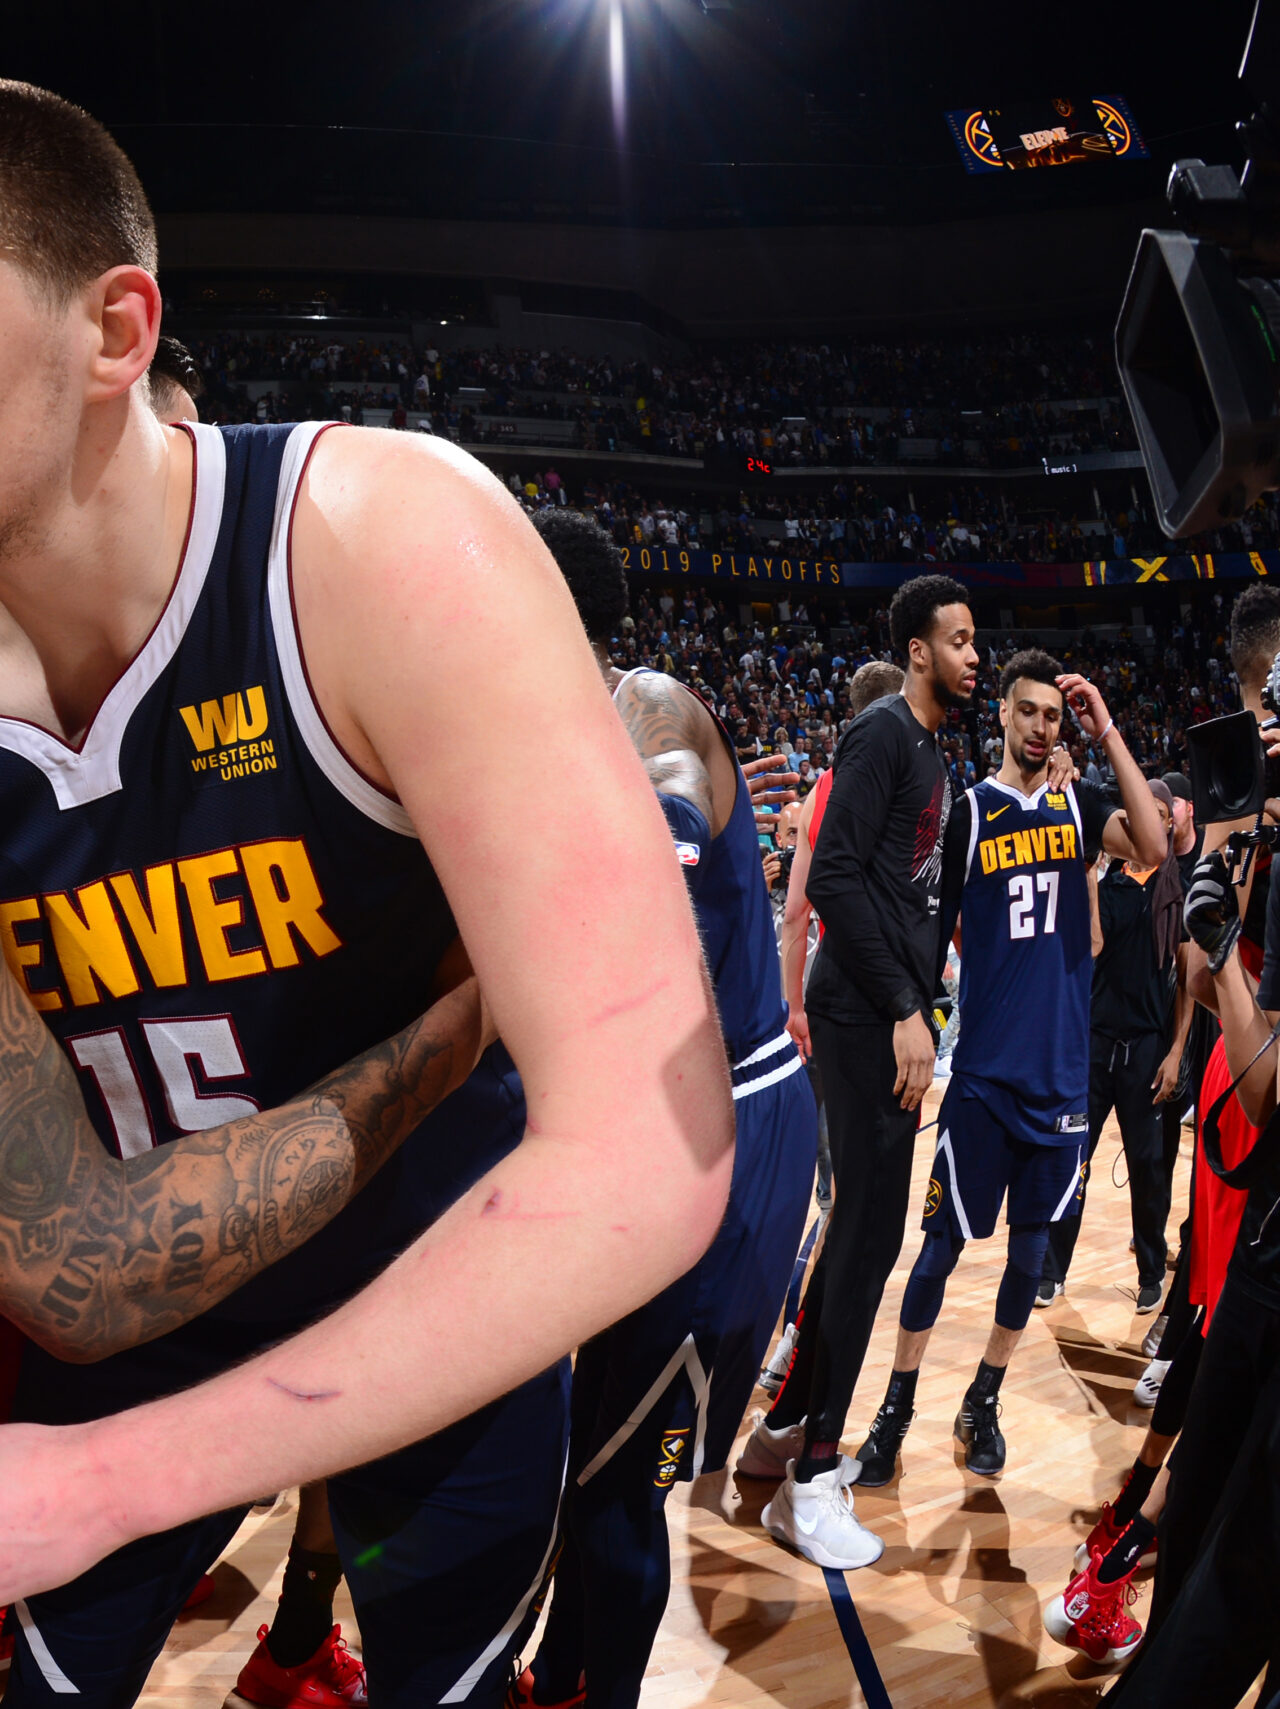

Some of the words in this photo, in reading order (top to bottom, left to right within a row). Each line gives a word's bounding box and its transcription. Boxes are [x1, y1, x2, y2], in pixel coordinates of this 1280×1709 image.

[620, 547, 691, 572] 2019
[712, 554, 840, 584] PLAYOFFS
[179, 685, 269, 752] WU
[191, 739, 274, 772] WESTERN
[221, 755, 277, 781] UNION
[979, 824, 1077, 875] DENVER
[1008, 871, 1060, 939] 27
[65, 1013, 264, 1161] 15
